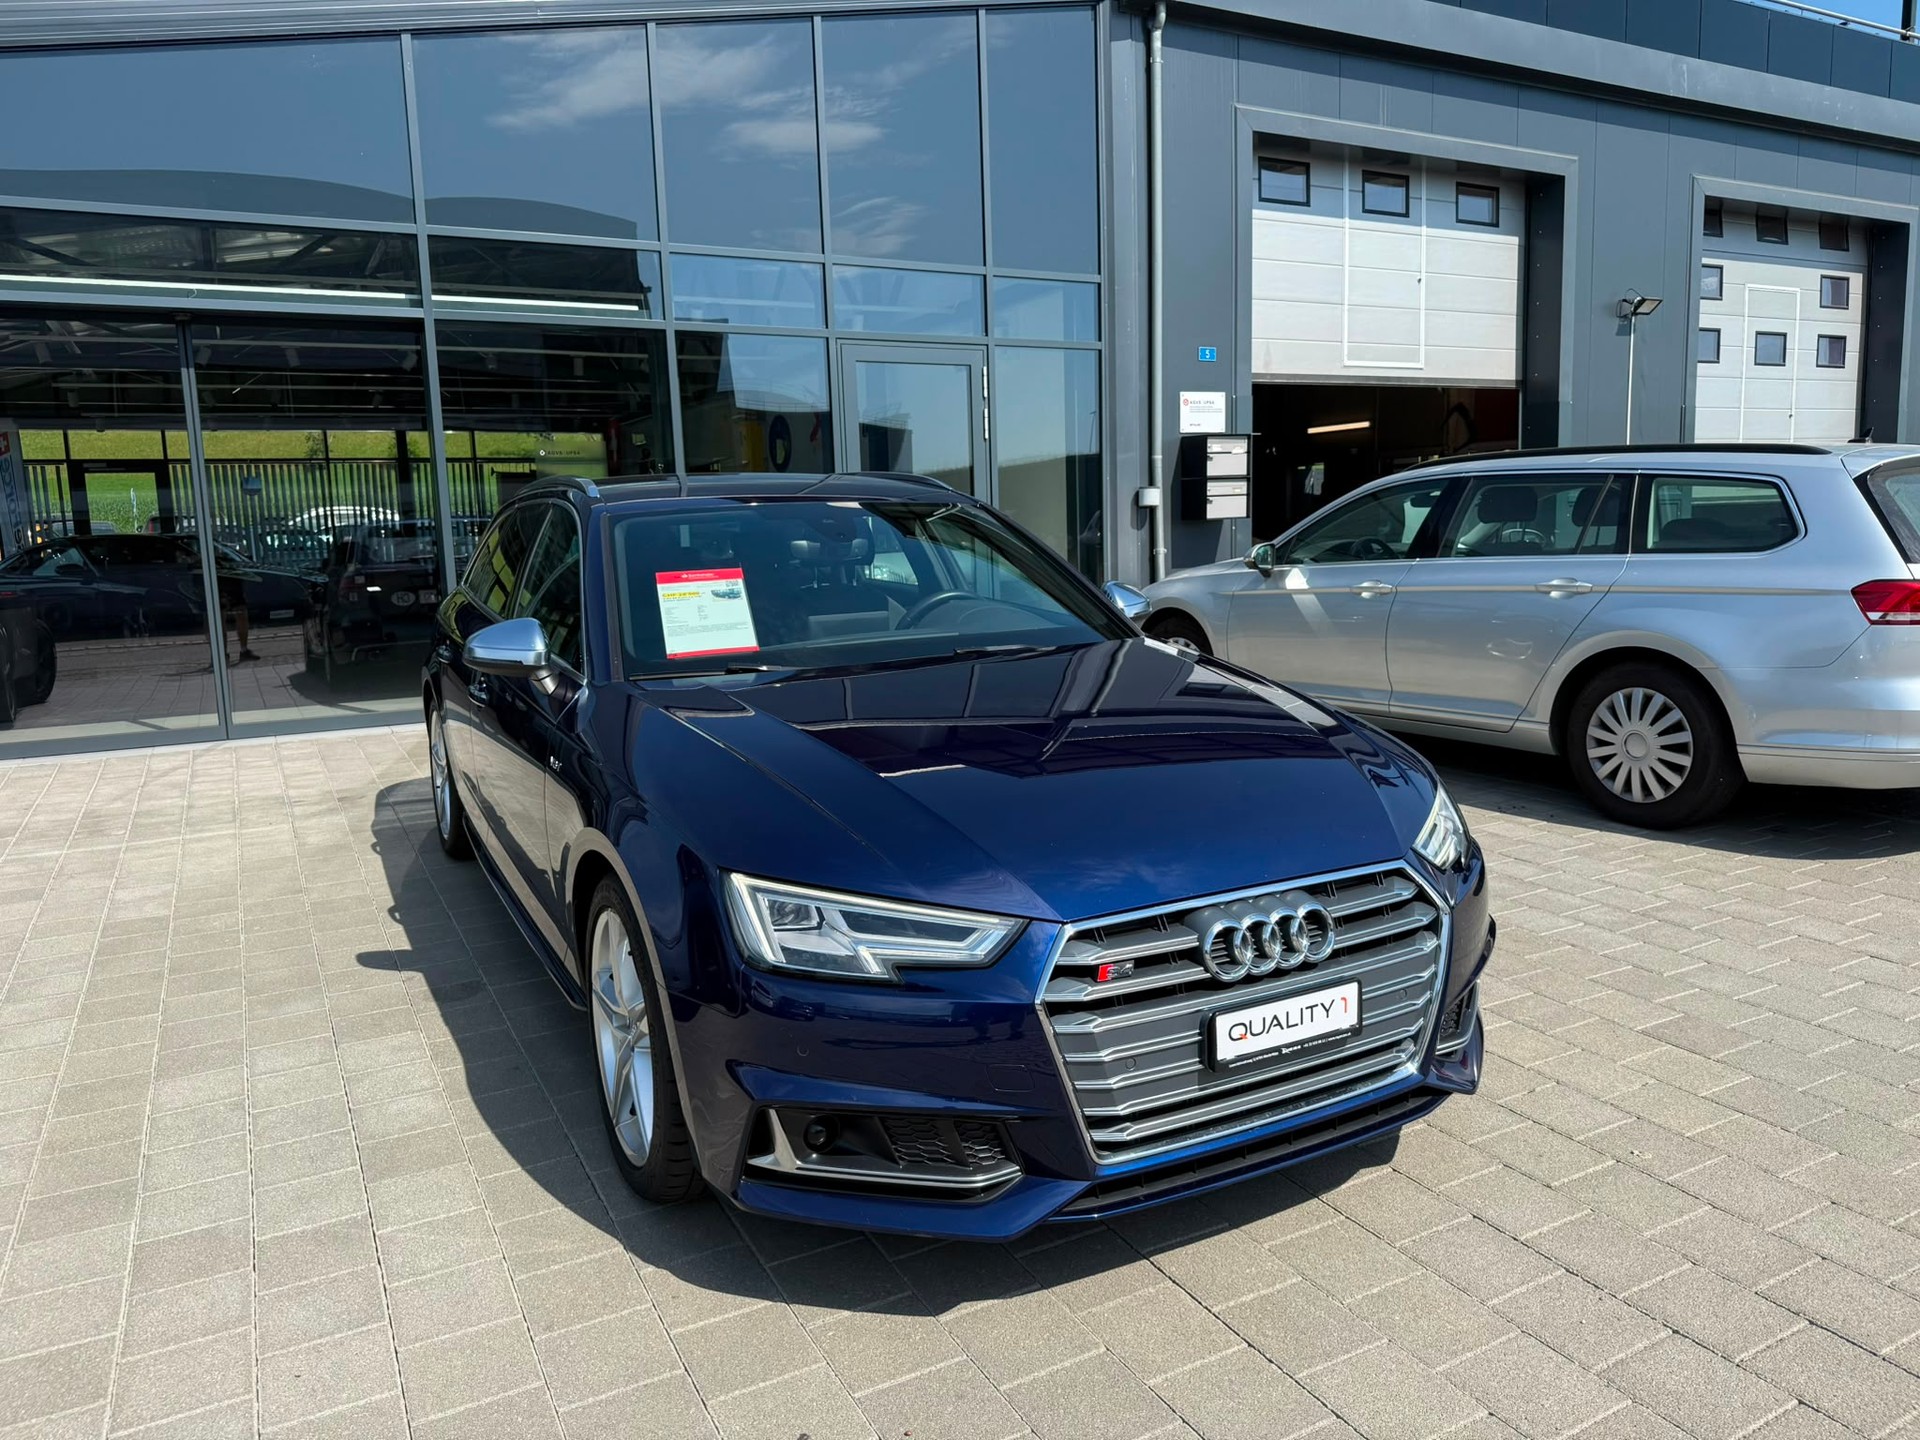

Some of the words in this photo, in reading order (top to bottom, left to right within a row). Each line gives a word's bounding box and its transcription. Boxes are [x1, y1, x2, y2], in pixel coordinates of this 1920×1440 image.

[1205, 349, 1211, 359] 5
[1228, 999, 1335, 1042] QUALITY
[1340, 996, 1348, 1014] 1
